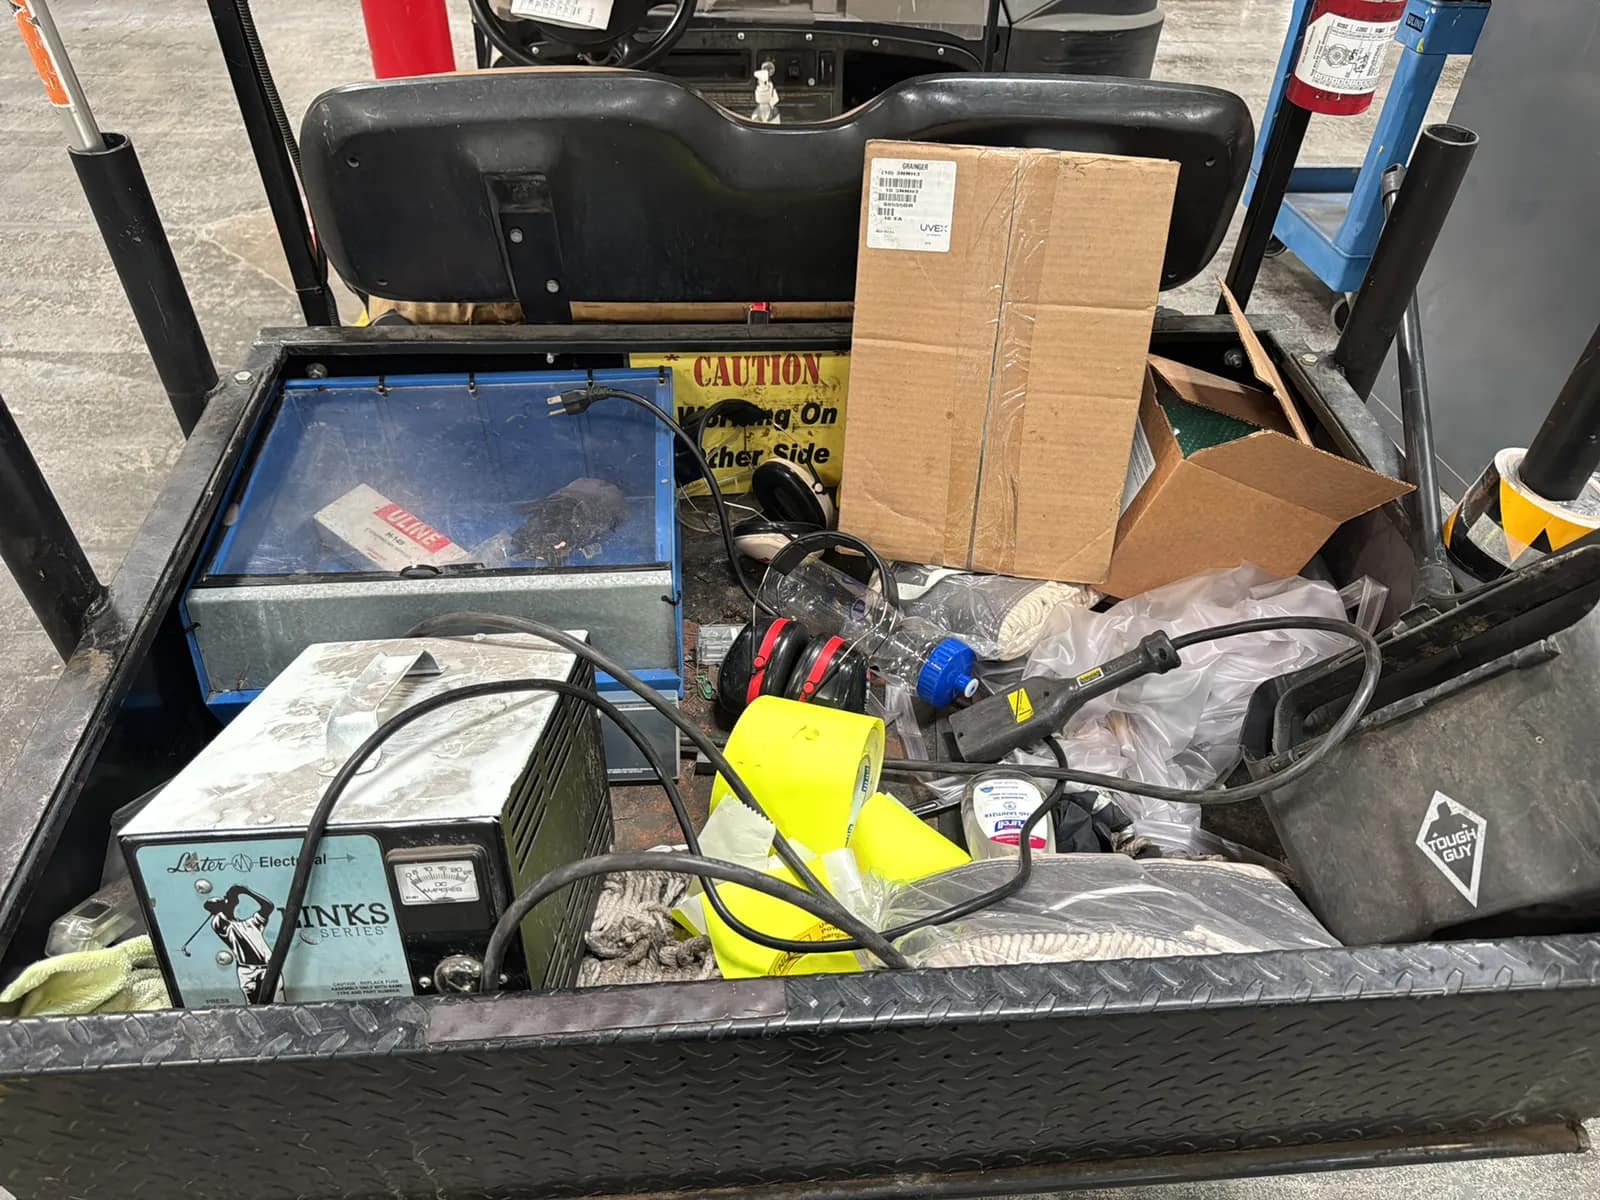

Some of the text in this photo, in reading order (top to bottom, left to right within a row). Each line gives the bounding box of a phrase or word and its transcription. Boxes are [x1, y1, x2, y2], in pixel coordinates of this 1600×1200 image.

[902, 162, 928, 170] GRAINGER
[920, 223, 948, 232] UVEX
[693, 353, 822, 387] CAUTION
[801, 402, 838, 424] On
[773, 443, 830, 465] Side
[388, 509, 441, 545] ULINE
[1427, 828, 1477, 852] TOUGH
[259, 853, 327, 868] Electal
[1442, 843, 1472, 863] GUY
[320, 926, 385, 938] SERIES
